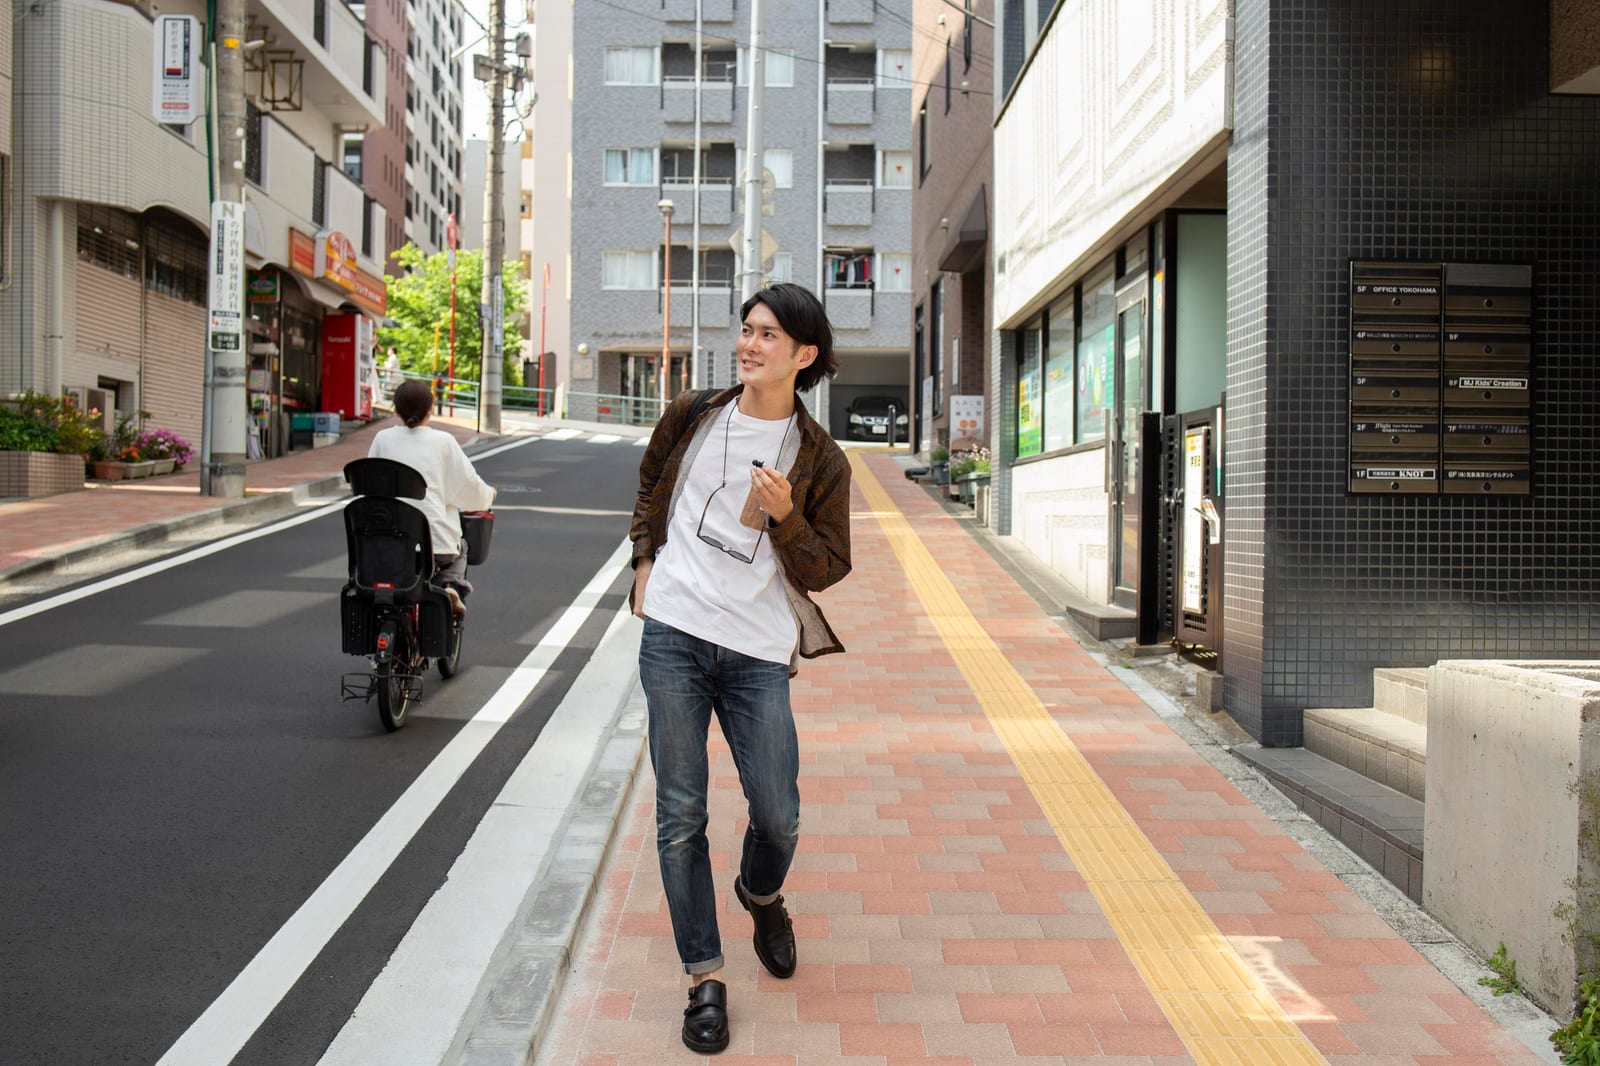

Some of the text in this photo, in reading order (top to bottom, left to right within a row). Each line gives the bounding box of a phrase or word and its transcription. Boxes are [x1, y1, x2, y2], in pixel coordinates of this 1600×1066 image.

[222, 203, 235, 218] N
[1356, 470, 1366, 478] 1F
[1399, 470, 1425, 478] KNOT
